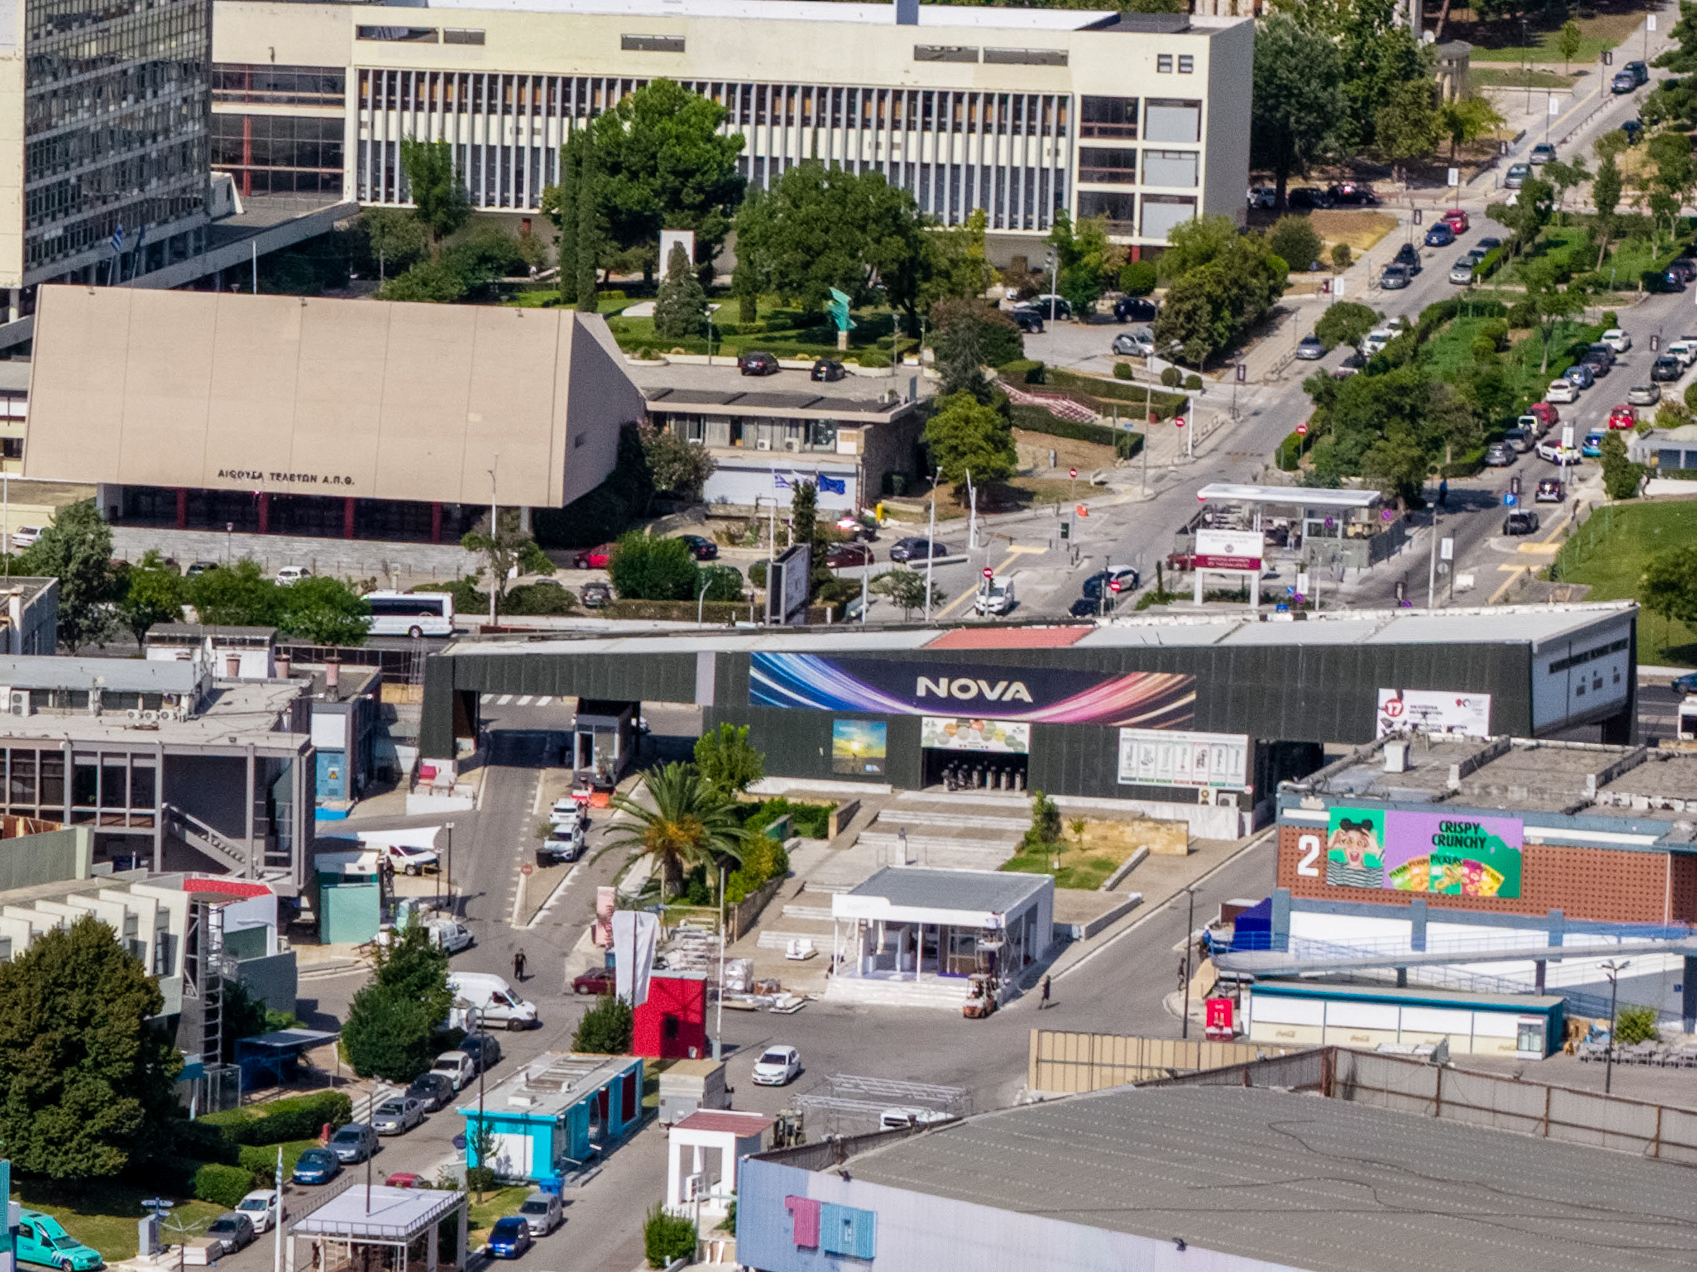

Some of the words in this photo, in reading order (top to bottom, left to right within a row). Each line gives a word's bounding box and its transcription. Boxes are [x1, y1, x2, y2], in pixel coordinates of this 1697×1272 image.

[269, 472, 317, 483] ΤΕΛΕΤΩΝ
[916, 675, 1033, 703] NOVA
[1385, 702, 1402, 716] 17
[1439, 820, 1481, 835] CRISPY
[1432, 833, 1487, 849] CRUNCHY
[1297, 834, 1320, 878] 2
[784, 1194, 878, 1260] 10
